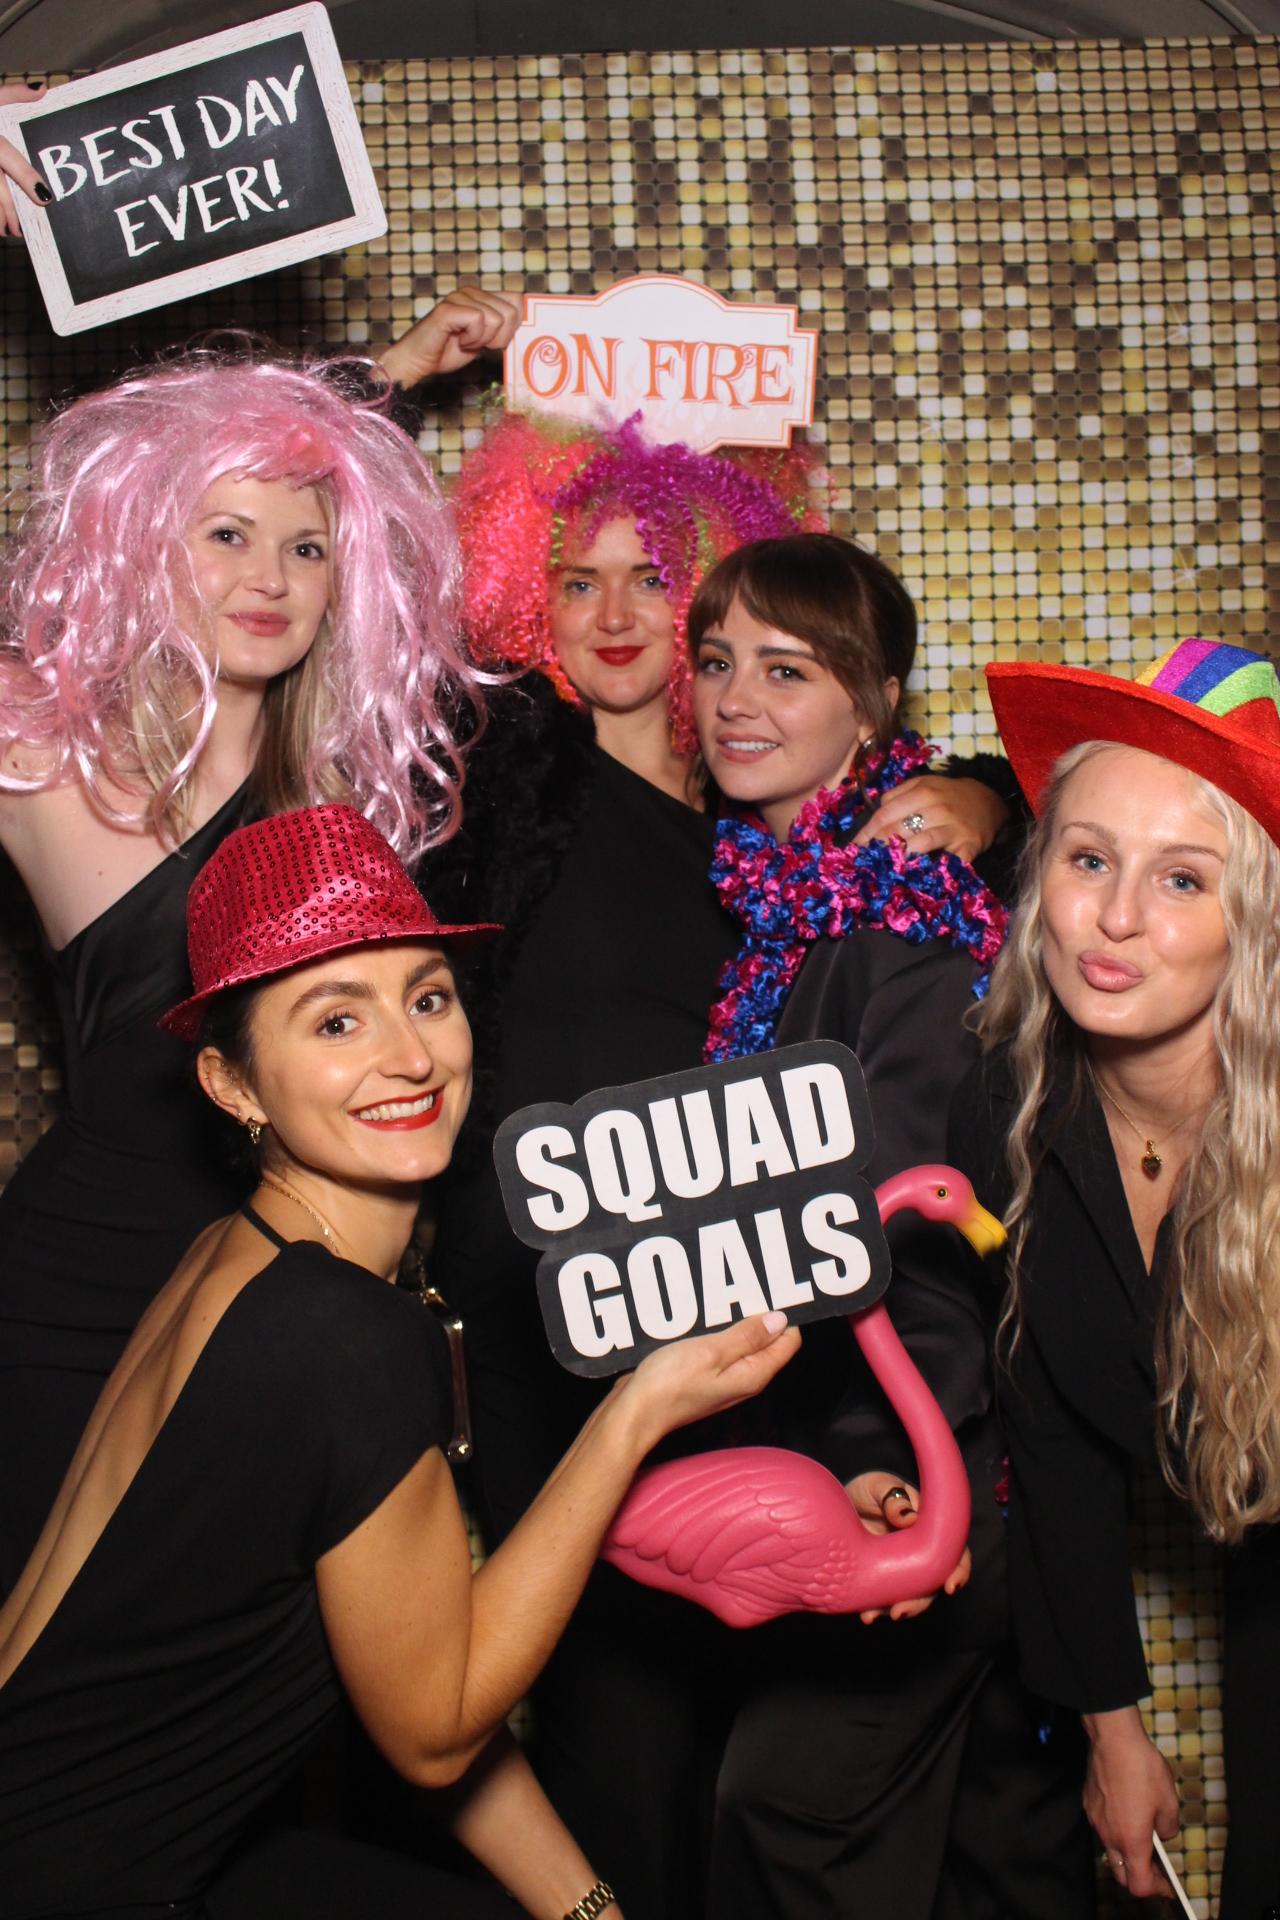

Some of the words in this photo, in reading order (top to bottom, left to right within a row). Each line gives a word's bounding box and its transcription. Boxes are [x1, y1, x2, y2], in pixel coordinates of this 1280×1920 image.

[38, 105, 185, 201] BEST
[196, 65, 304, 149] DAY
[114, 159, 289, 257] EVER!
[523, 333, 624, 399] ON
[640, 337, 793, 409] FIRE
[515, 1062, 856, 1232] SQUAD
[557, 1192, 872, 1358] GOALS
